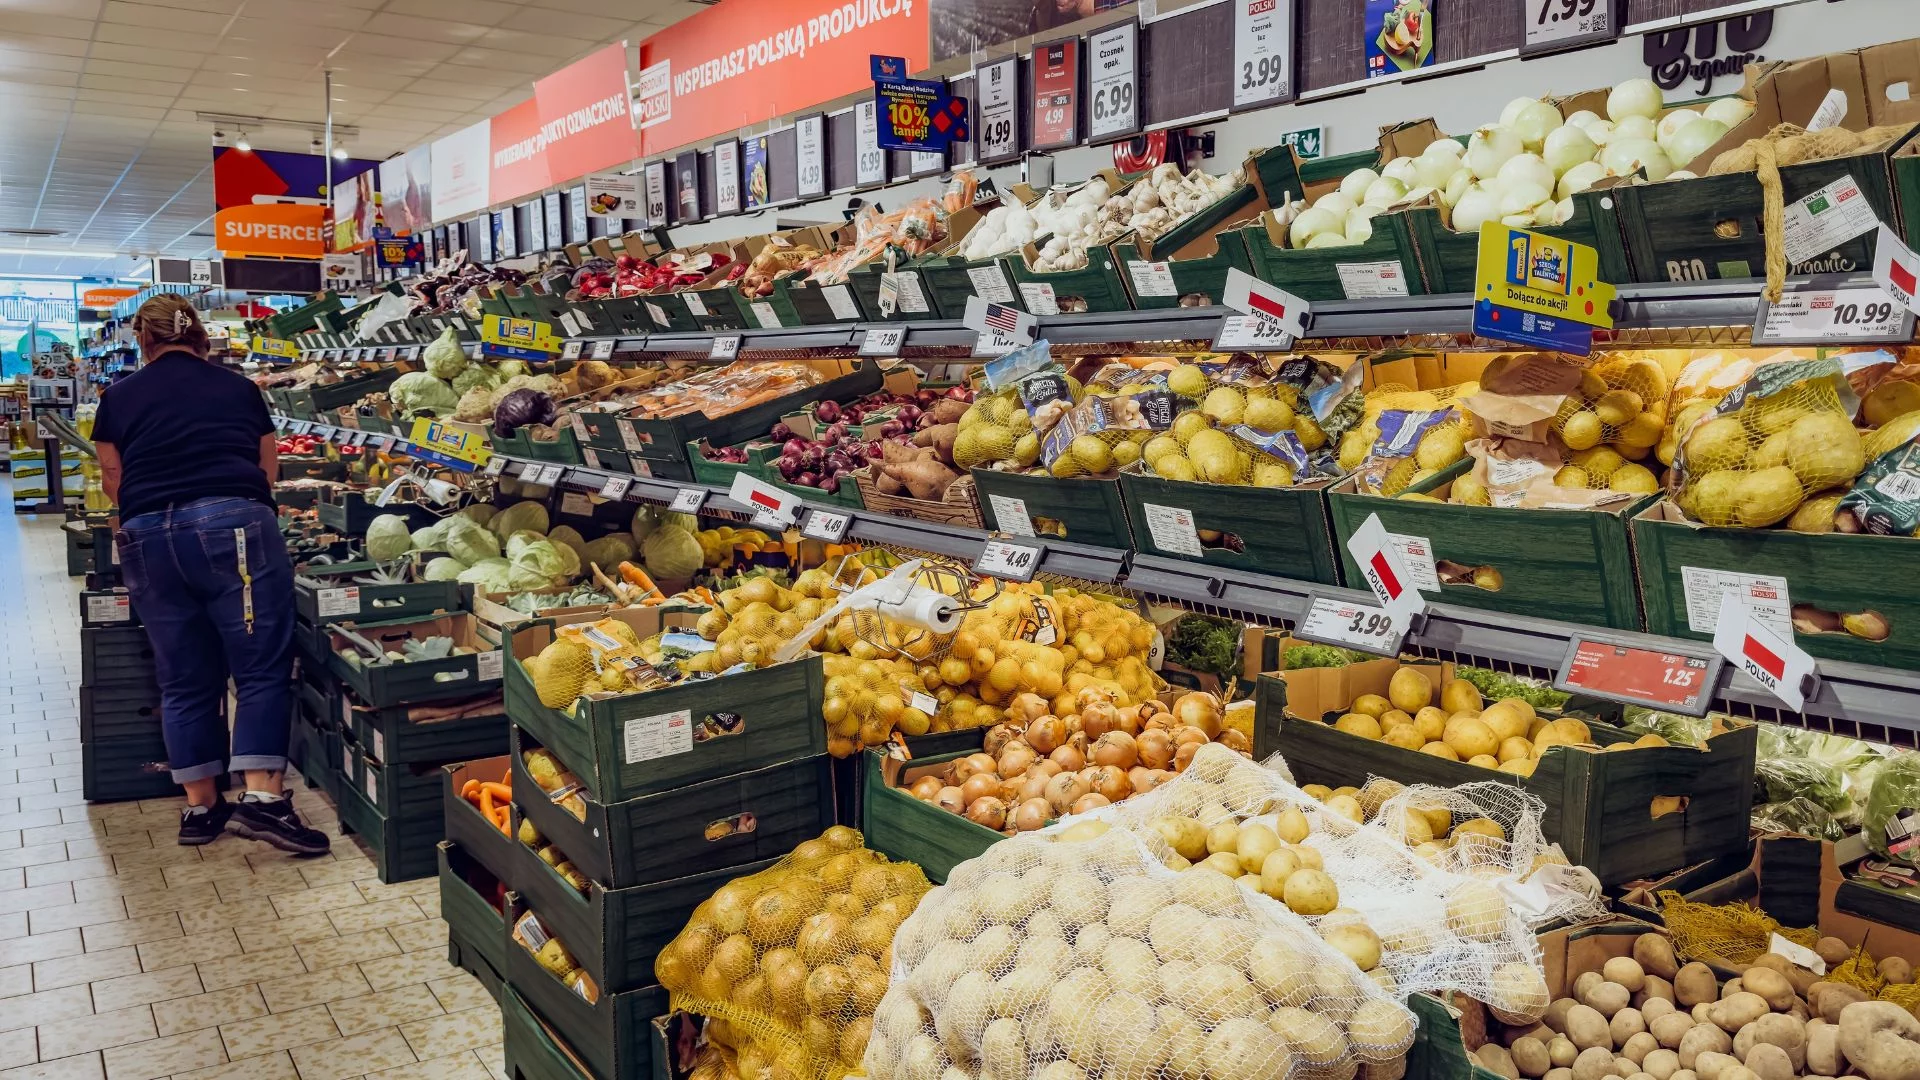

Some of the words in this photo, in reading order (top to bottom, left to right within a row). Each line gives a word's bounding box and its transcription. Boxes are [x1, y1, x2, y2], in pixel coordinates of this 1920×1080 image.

[1249, 0, 1275, 15] POLSKI
[1099, 44, 1125, 59] Czosnek
[674, 48, 745, 96] WSPIERASZ
[748, 25, 806, 70] POLSKĄ
[1103, 58, 1121, 69] opak.
[1242, 55, 1282, 90] 3.99
[916, 86, 935, 94] Rodziny
[641, 94, 669, 120] POLSKI
[1036, 98, 1049, 109] 6.99
[1093, 82, 1133, 120] 6.99
[568, 92, 626, 135] OZNACZONE
[888, 103, 930, 126] 10%
[1045, 108, 1064, 125] 4.99
[893, 125, 928, 140] taniej!
[984, 120, 1011, 146] 4.99
[860, 151, 881, 173] 6.99
[801, 165, 820, 185] 4.99
[720, 186, 736, 203] 3.99
[1802, 189, 1827, 204] POLSKA
[650, 202, 663, 218] 4.99
[383, 247, 406, 258] 10%
[192, 272, 210, 281] 2.89
[1507, 288, 1534, 305] Dołącz
[1536, 295, 1547, 306] do
[1547, 299, 1568, 312] akcji!
[1890, 283, 1910, 307] POLSKA
[1770, 301, 1802, 310] Ziemniaki
[1834, 302, 1892, 325] 10.99
[1251, 308, 1278, 326] POLSKA
[881, 333, 898, 346] 7.99
[992, 328, 1005, 337] USA
[993, 337, 1015, 346] 11.
[1036, 388, 1058, 401] Lidla
[1146, 400, 1158, 424] Lidla
[751, 502, 774, 516] POLSKA
[824, 518, 842, 533] 4.49
[1006, 550, 1031, 568] 4.49
[1367, 568, 1390, 604] POLSKA
[1752, 590, 1777, 599] POLSKI
[1349, 611, 1392, 637] 3.99
[1687, 659, 1707, 668] -58%
[1663, 668, 1696, 687] 1.25
[1745, 659, 1776, 691] POLSKA
